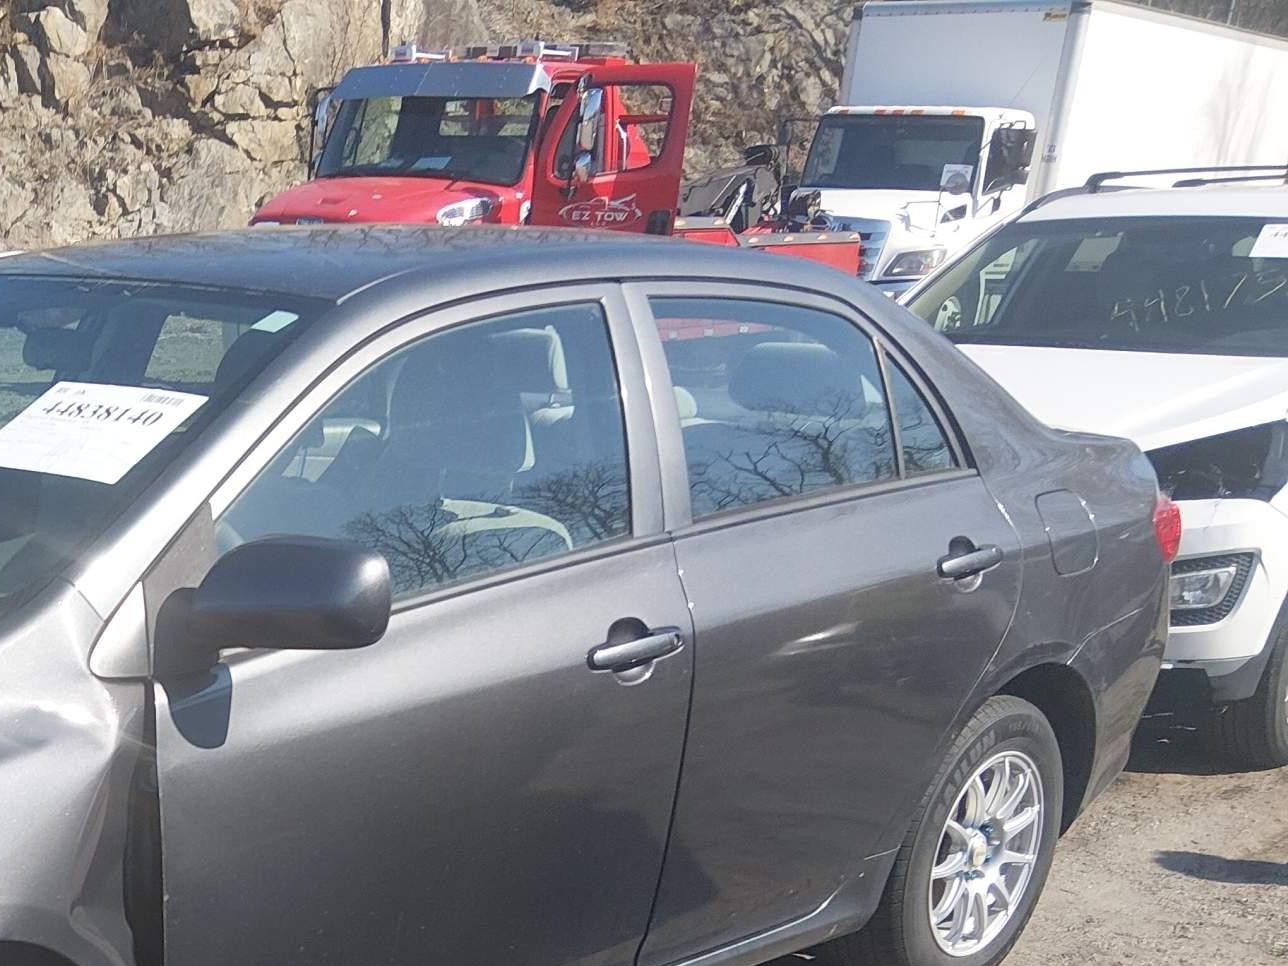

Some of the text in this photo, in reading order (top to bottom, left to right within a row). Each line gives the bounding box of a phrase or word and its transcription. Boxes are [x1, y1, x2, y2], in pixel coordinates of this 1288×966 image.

[572, 211, 629, 222] EZ TOW
[42, 400, 164, 426] 44838140
